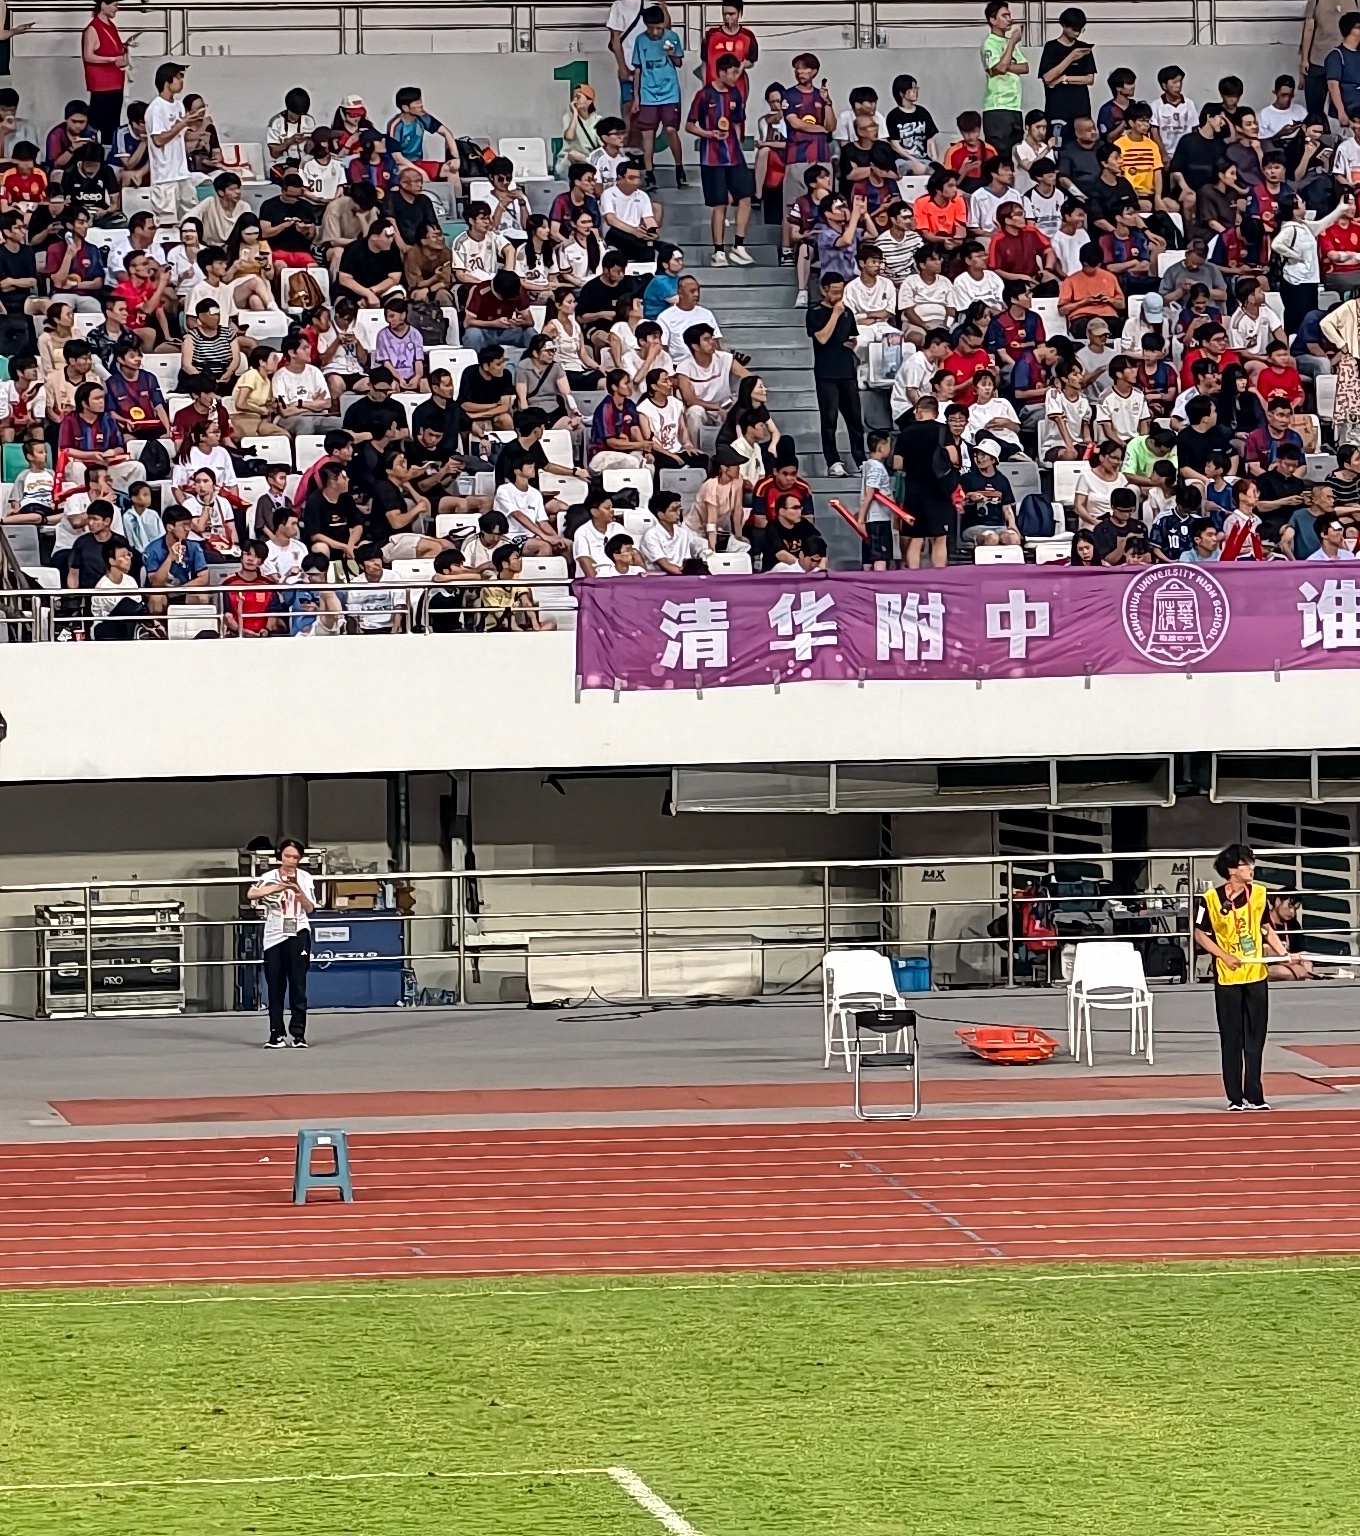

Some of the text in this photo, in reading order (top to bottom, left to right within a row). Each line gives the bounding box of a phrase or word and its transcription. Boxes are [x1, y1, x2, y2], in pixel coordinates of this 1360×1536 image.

[76, 191, 103, 204] Jeep
[1167, 534, 1180, 549] 10
[660, 590, 1050, 670] 清华附中
[103, 976, 124, 986] PRO
